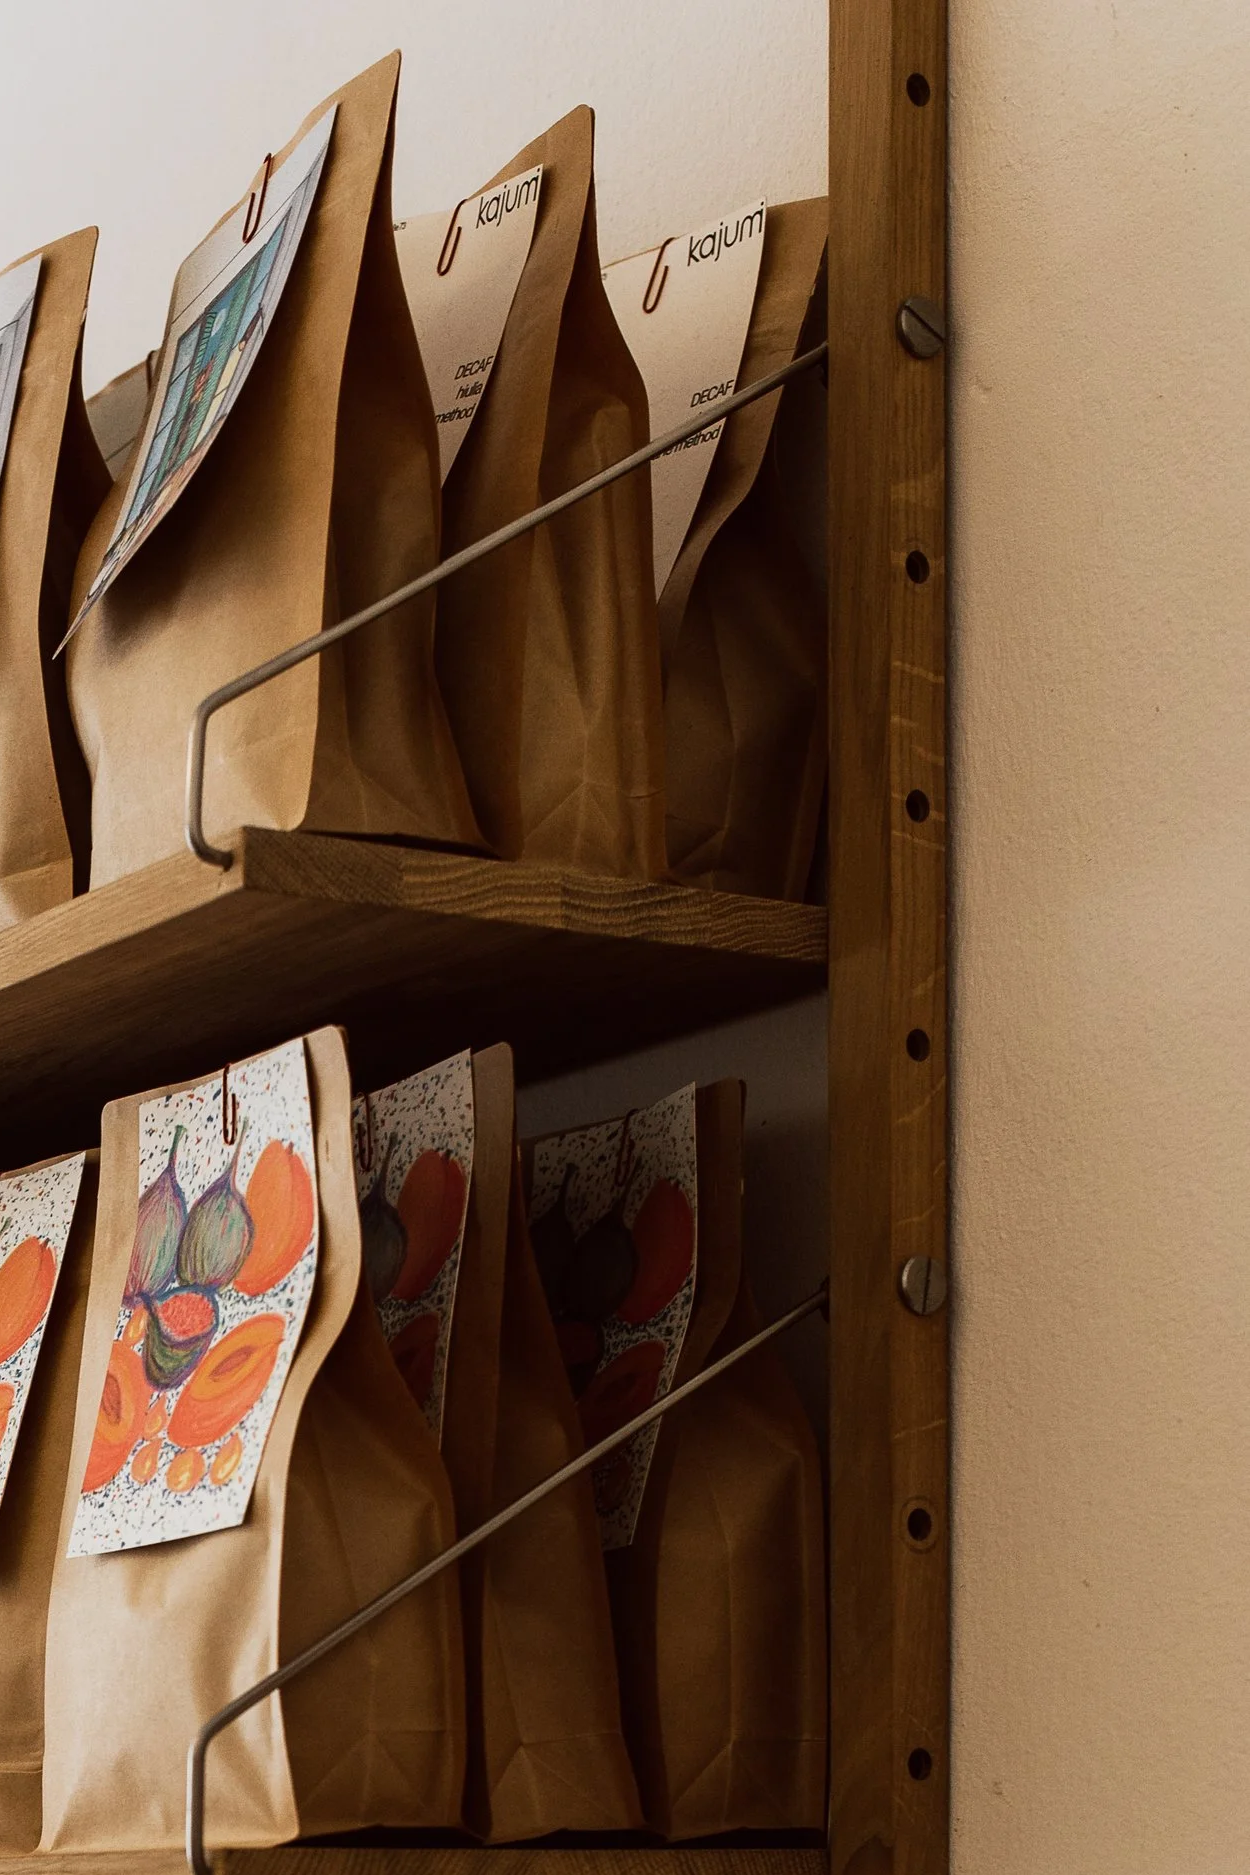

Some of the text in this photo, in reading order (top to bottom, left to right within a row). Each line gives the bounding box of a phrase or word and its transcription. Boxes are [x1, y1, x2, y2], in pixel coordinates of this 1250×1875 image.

[454, 355, 495, 380] DECAF
[690, 379, 735, 408] DECAF
[435, 402, 477, 424] method
